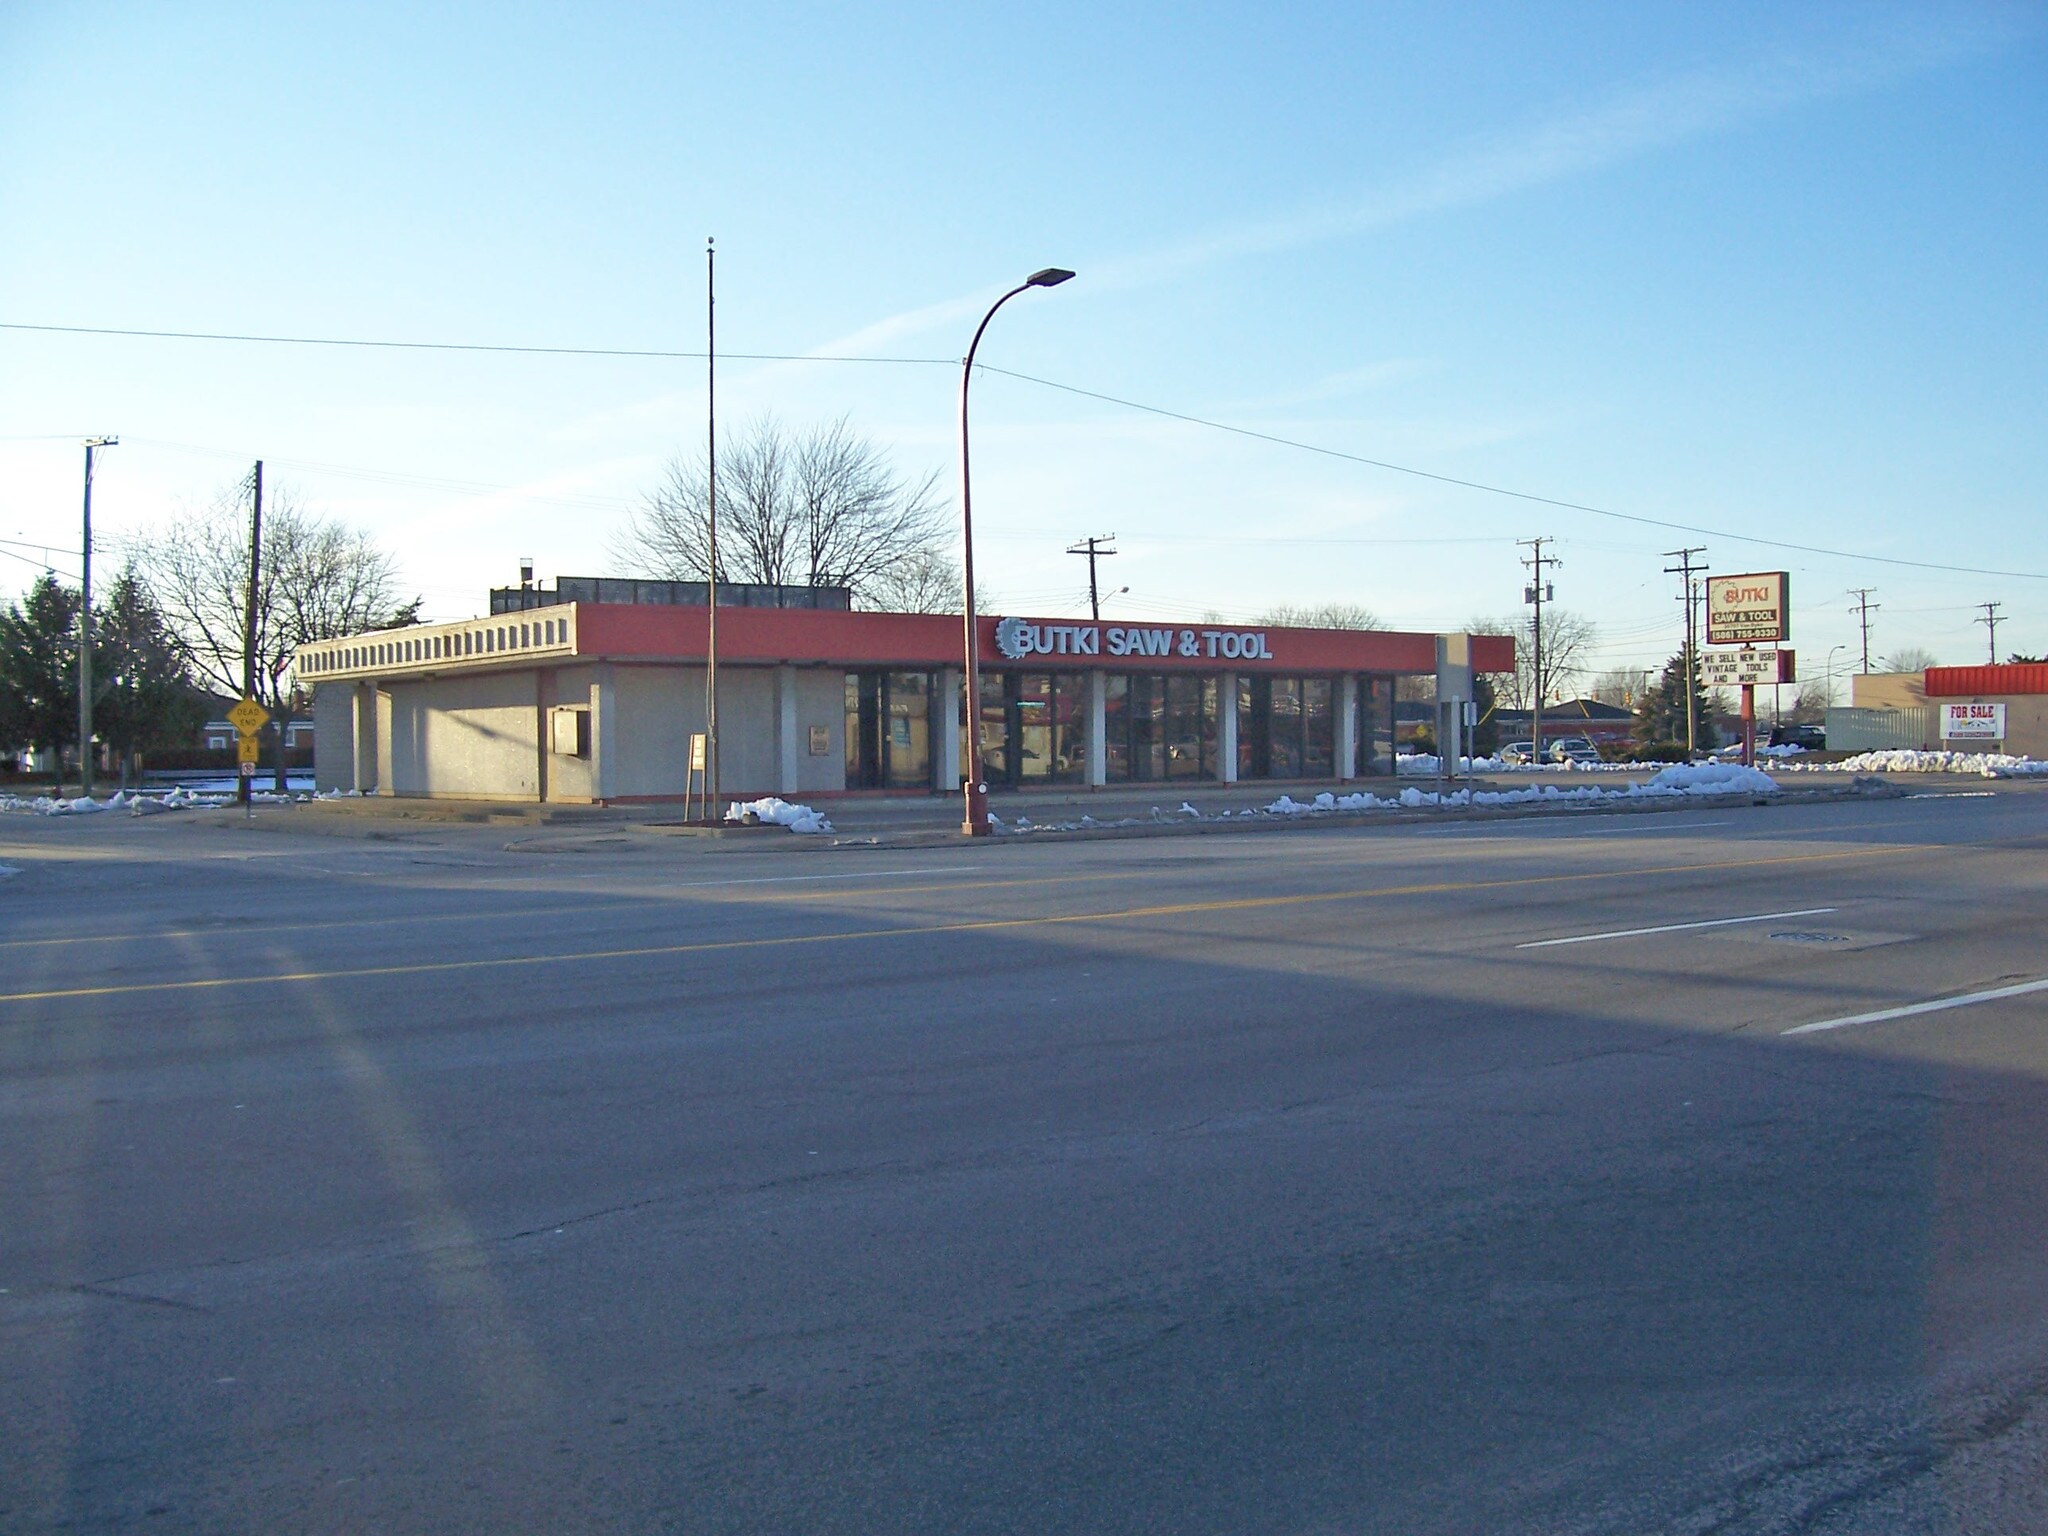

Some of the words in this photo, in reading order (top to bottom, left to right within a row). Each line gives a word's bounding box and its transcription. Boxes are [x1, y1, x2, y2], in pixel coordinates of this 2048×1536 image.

[1725, 587, 1769, 603] BUTKI
[1714, 613, 1736, 623] SAW
[1739, 612, 1746, 622] &
[1748, 611, 1774, 621] TOOL
[1014, 625, 1100, 655] BUTKI
[1106, 628, 1174, 657] SAW
[1178, 629, 1200, 657] &
[1202, 631, 1273, 660] TOOL
[1704, 655, 1714, 663] WE
[1719, 654, 1736, 663] SELL
[1740, 653, 1754, 662] NEW
[1759, 652, 1777, 662] USED
[1707, 664, 1738, 673] VINTAGE
[1746, 663, 1768, 672] TOOLS
[1738, 674, 1758, 682] MORE
[237, 708, 259, 716] DEAD
[1950, 706, 1968, 718] FOR
[1970, 706, 1994, 718] SALE
